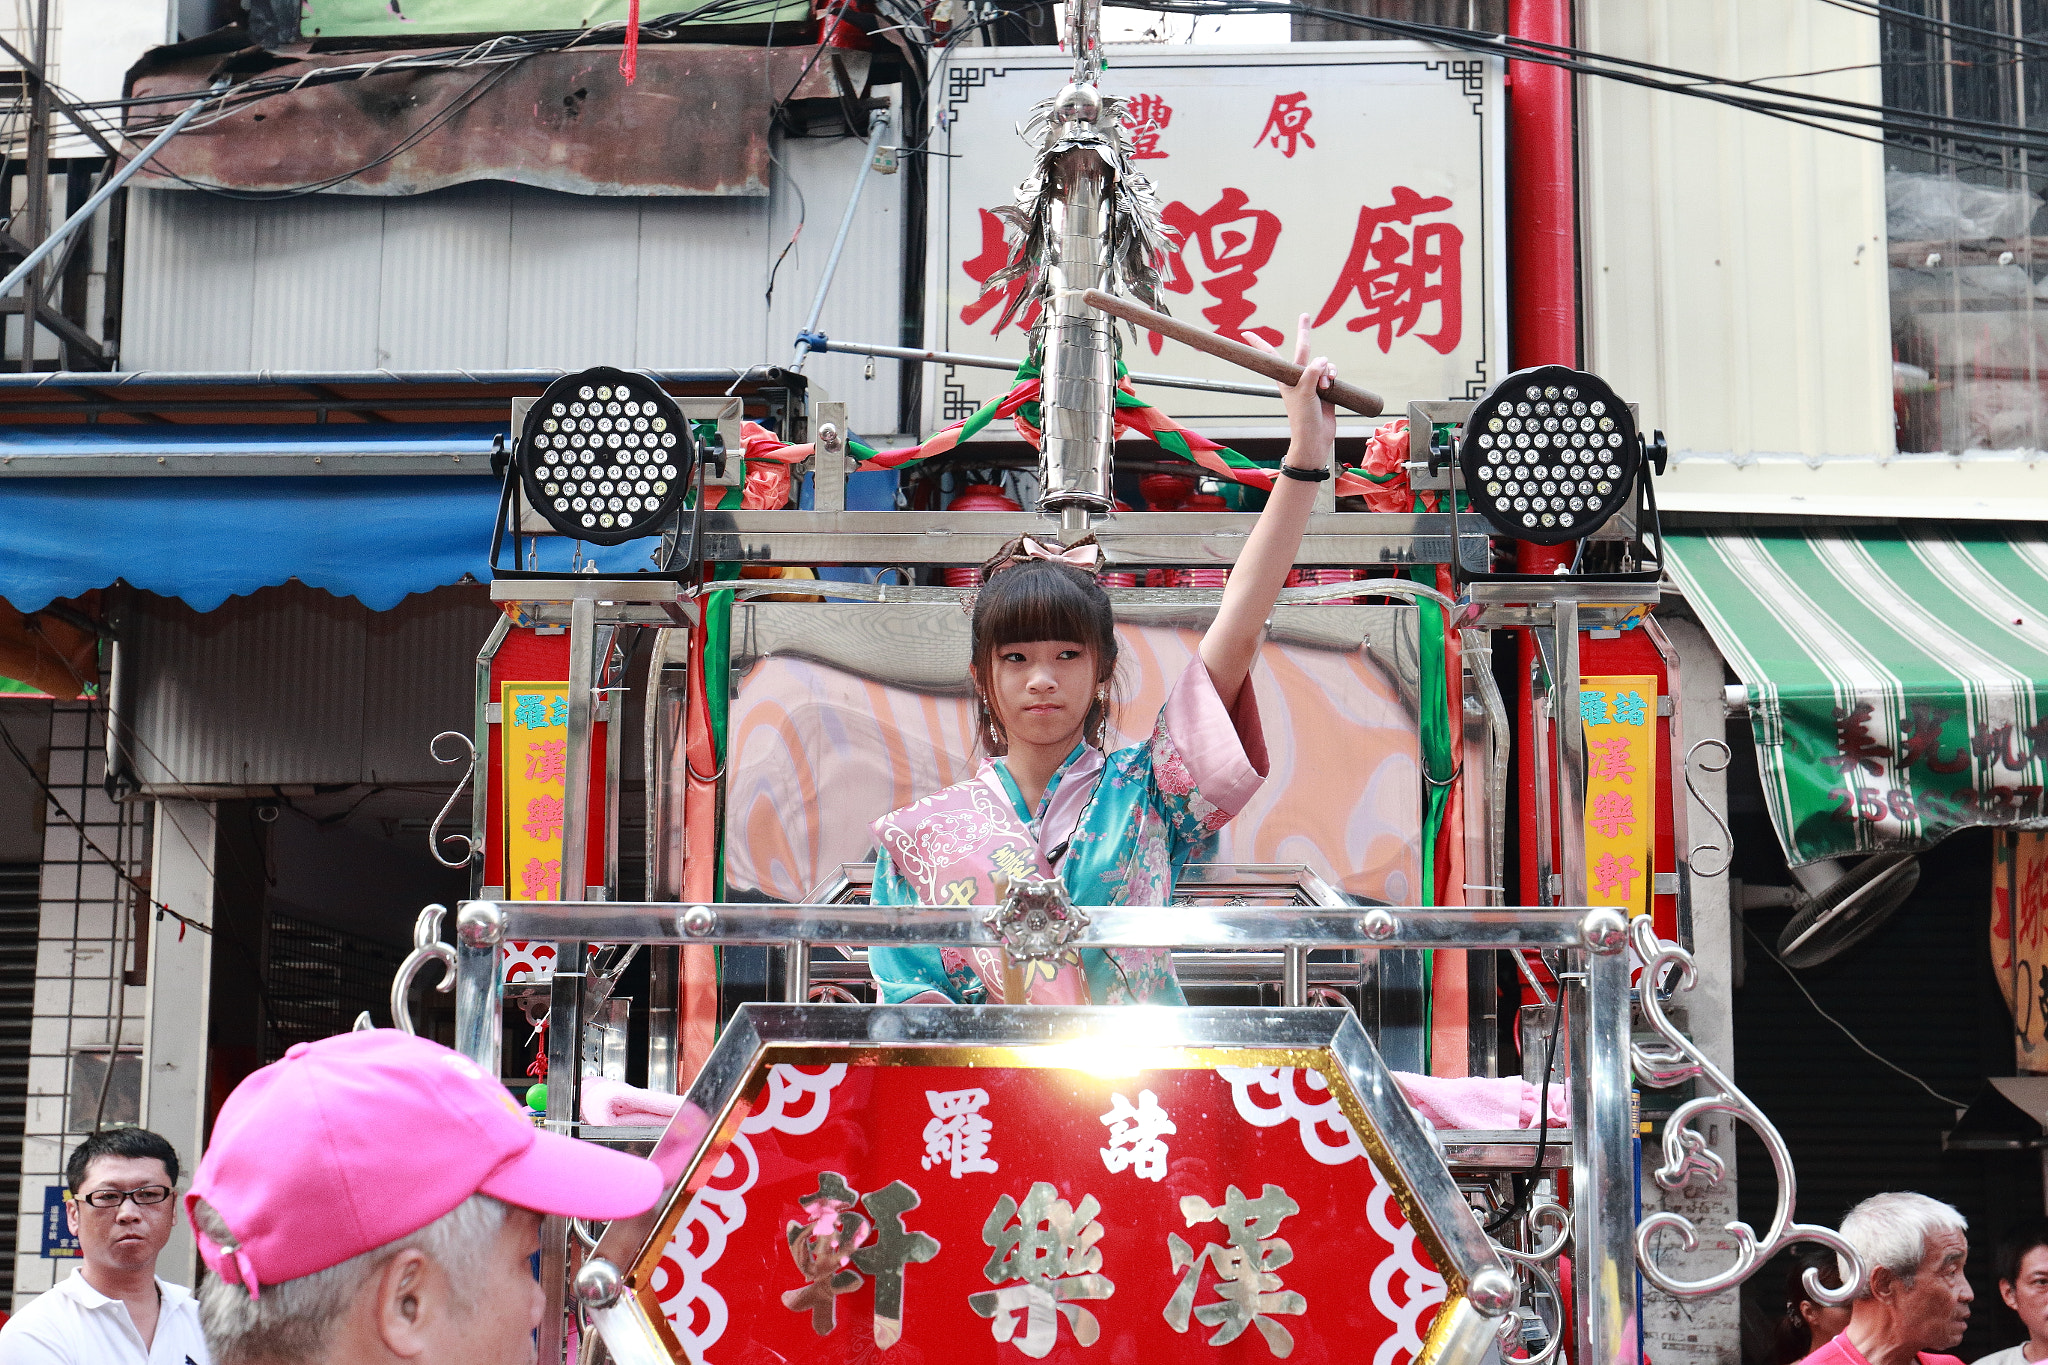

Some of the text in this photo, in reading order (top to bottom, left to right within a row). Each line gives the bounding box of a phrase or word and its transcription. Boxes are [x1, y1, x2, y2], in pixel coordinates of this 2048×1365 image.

[1122, 91, 1316, 160] 豐原
[1580, 690, 1648, 727] 諸羅
[521, 739, 567, 901] 漢樂軒
[1588, 737, 1641, 901] 漢樂軒
[781, 1171, 1308, 1360] 漢樂軒
